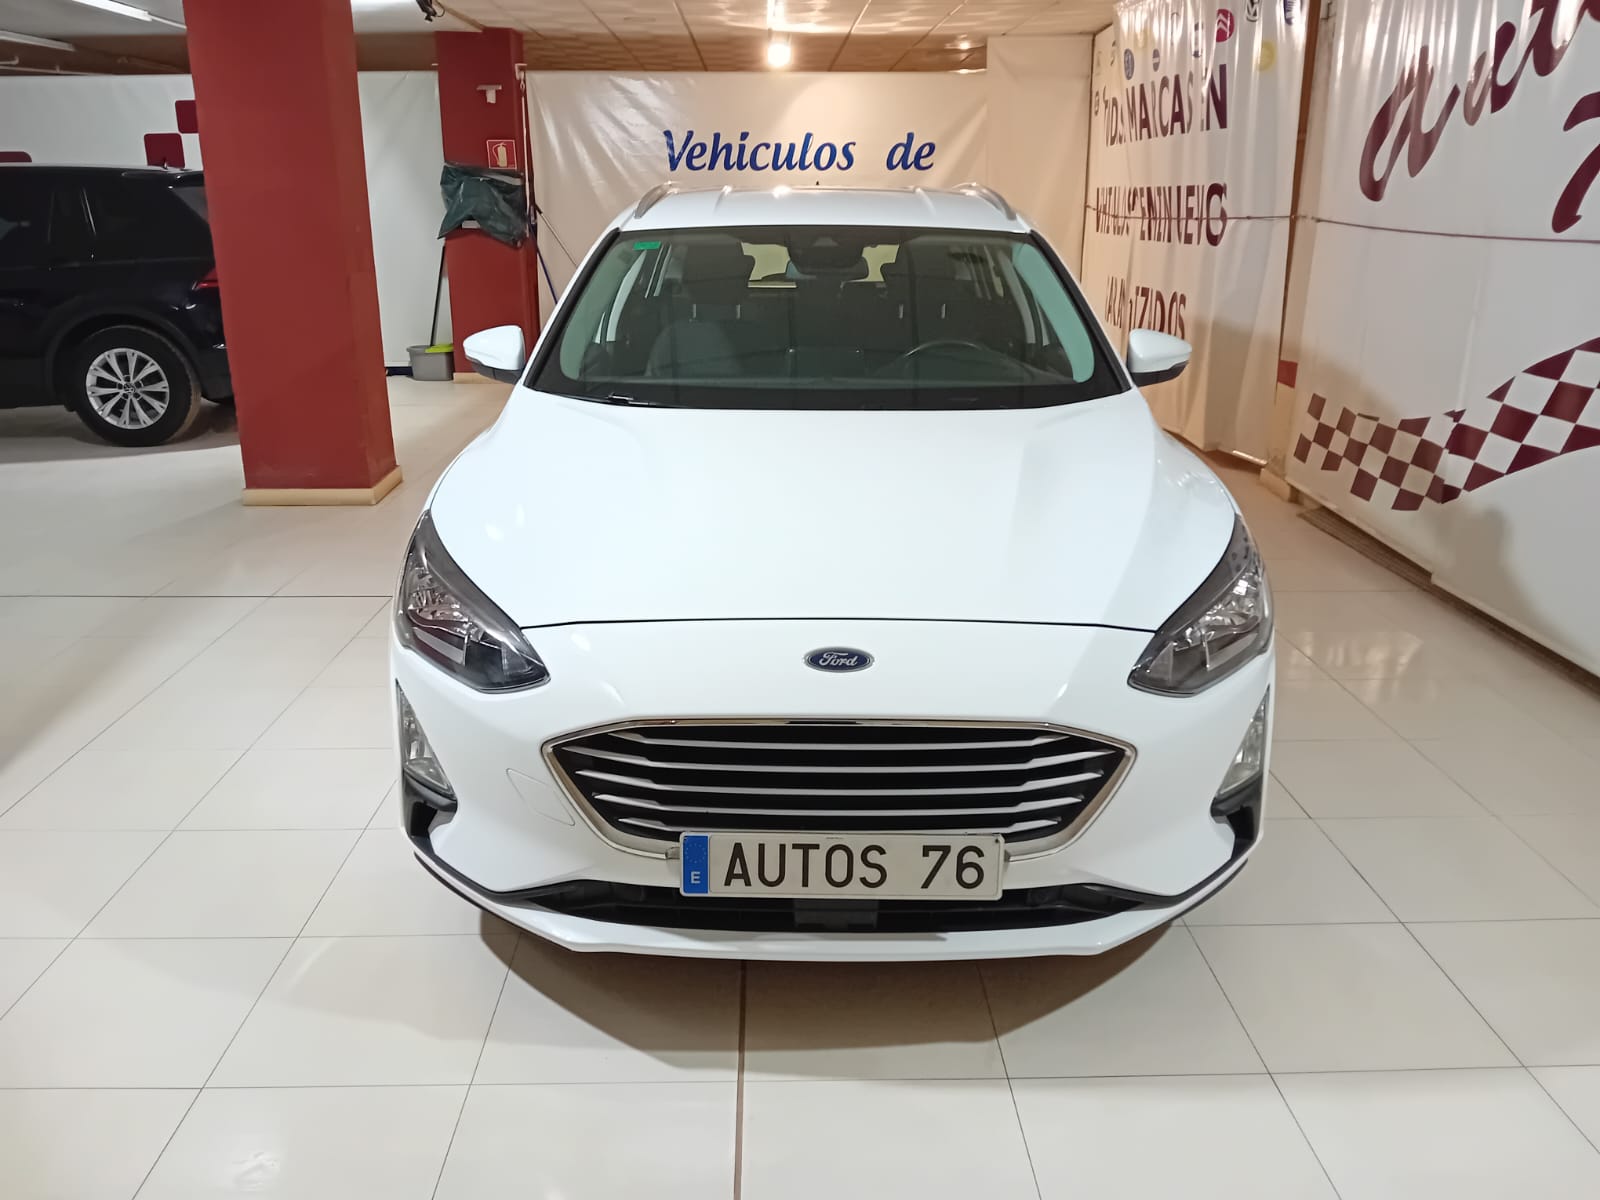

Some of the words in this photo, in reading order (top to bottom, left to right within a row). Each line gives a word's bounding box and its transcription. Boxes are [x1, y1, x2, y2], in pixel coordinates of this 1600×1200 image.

[886, 132, 936, 171] de
[818, 651, 858, 667] Ford
[690, 871, 700, 884] E
[723, 842, 888, 889] AUTOS
[920, 845, 986, 890] 76
